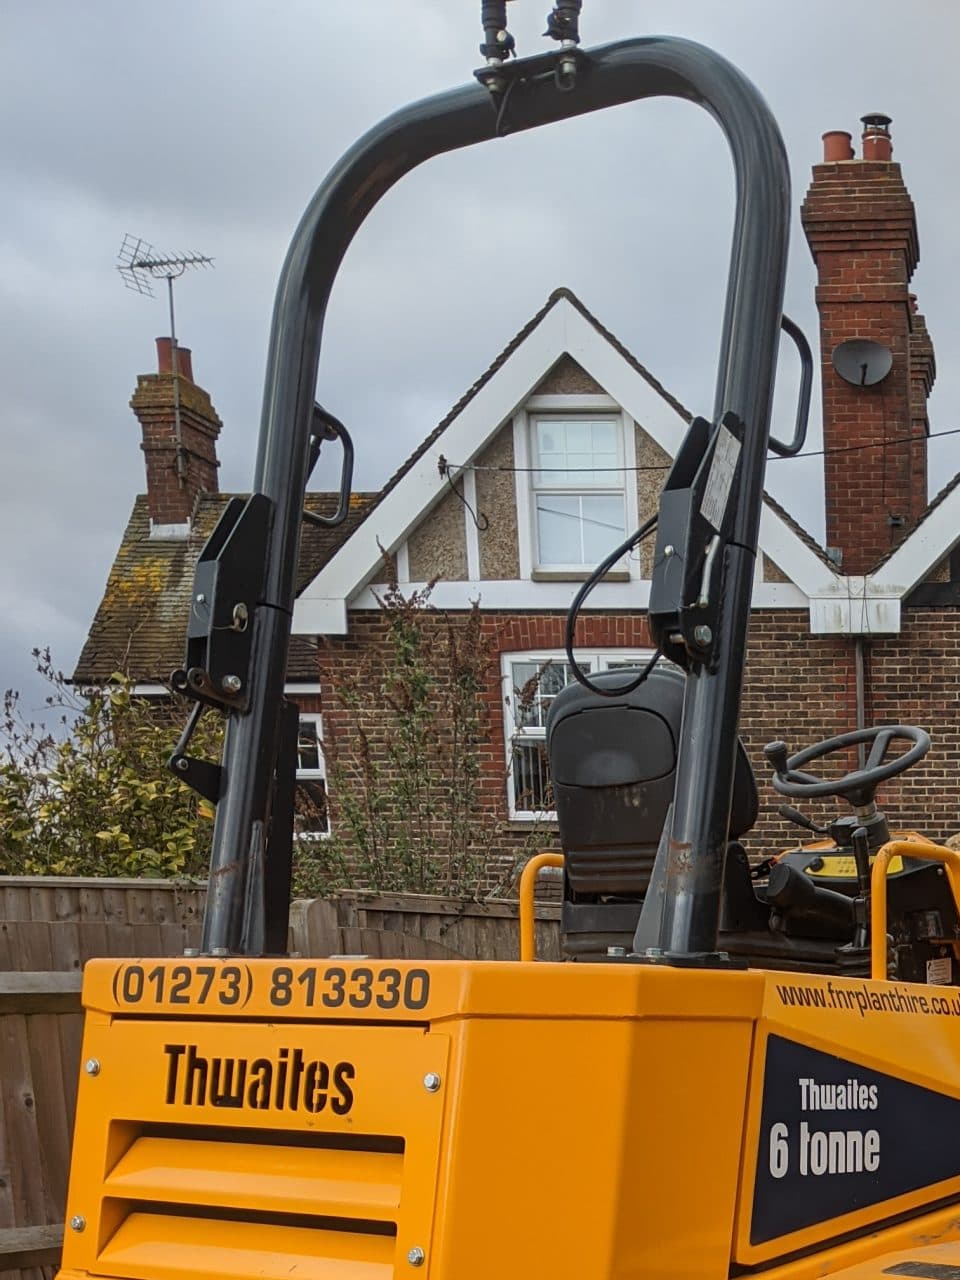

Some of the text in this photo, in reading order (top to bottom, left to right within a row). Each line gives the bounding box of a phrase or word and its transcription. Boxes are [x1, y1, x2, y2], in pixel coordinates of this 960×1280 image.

[112, 963, 431, 1011] (01273) 813330
[163, 1043, 356, 1116] Thwaites
[798, 1078, 879, 1111] Thwaites
[769, 1121, 881, 1179] 6 tonne
